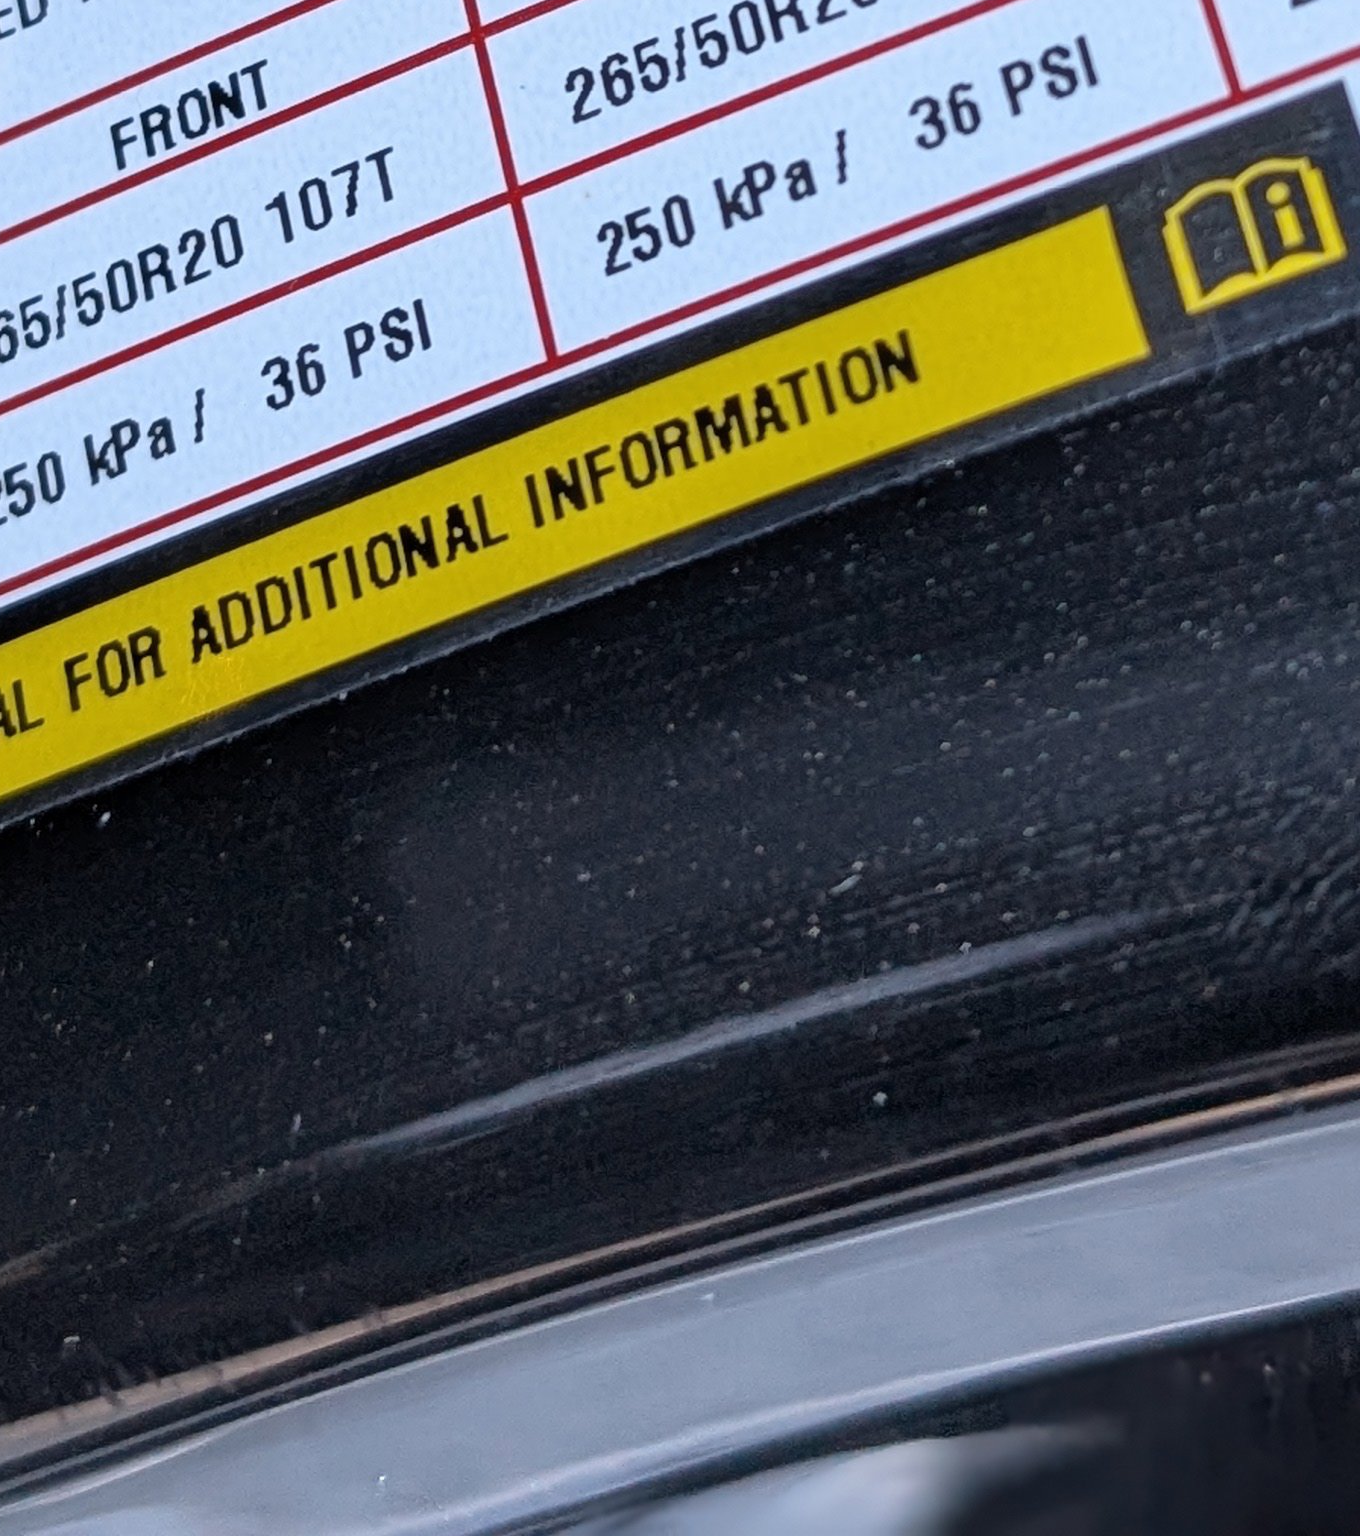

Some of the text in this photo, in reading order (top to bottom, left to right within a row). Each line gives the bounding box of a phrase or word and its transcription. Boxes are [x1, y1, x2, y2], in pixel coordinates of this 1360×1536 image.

[108, 57, 269, 172] FRONT
[262, 144, 395, 245] 107T
[595, 192, 697, 278] 250
[711, 157, 818, 231] kPa
[907, 80, 983, 151] 36
[997, 33, 1100, 118] PSI
[81, 415, 178, 487] kPa
[258, 341, 328, 412] 36
[341, 296, 433, 380] PSI
[61, 624, 168, 714] FOR
[189, 492, 510, 665] ADDITIONAL
[523, 328, 920, 529] INFORMATION
